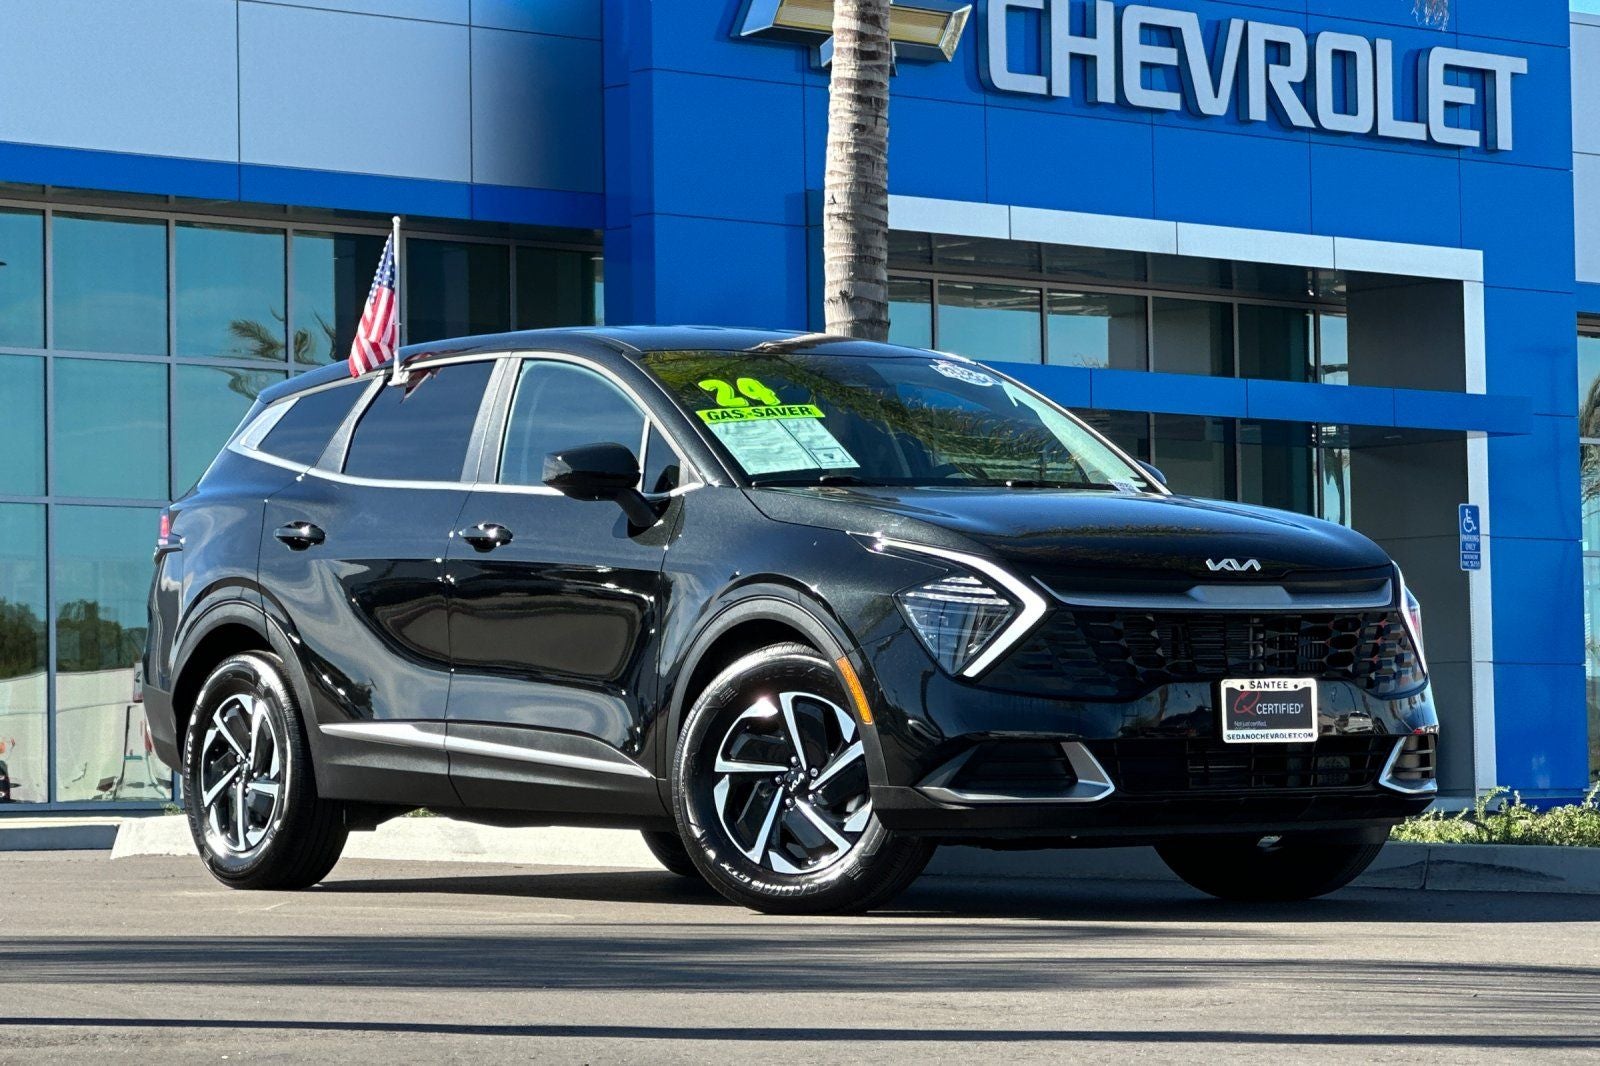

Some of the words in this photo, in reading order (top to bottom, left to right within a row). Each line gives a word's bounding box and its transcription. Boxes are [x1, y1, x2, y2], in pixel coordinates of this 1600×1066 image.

[987, 0, 1528, 151] CHEVROLET
[1205, 558, 1262, 572] KIA
[1249, 681, 1289, 689] SANTEE
[1256, 703, 1301, 715] CERTIFIED
